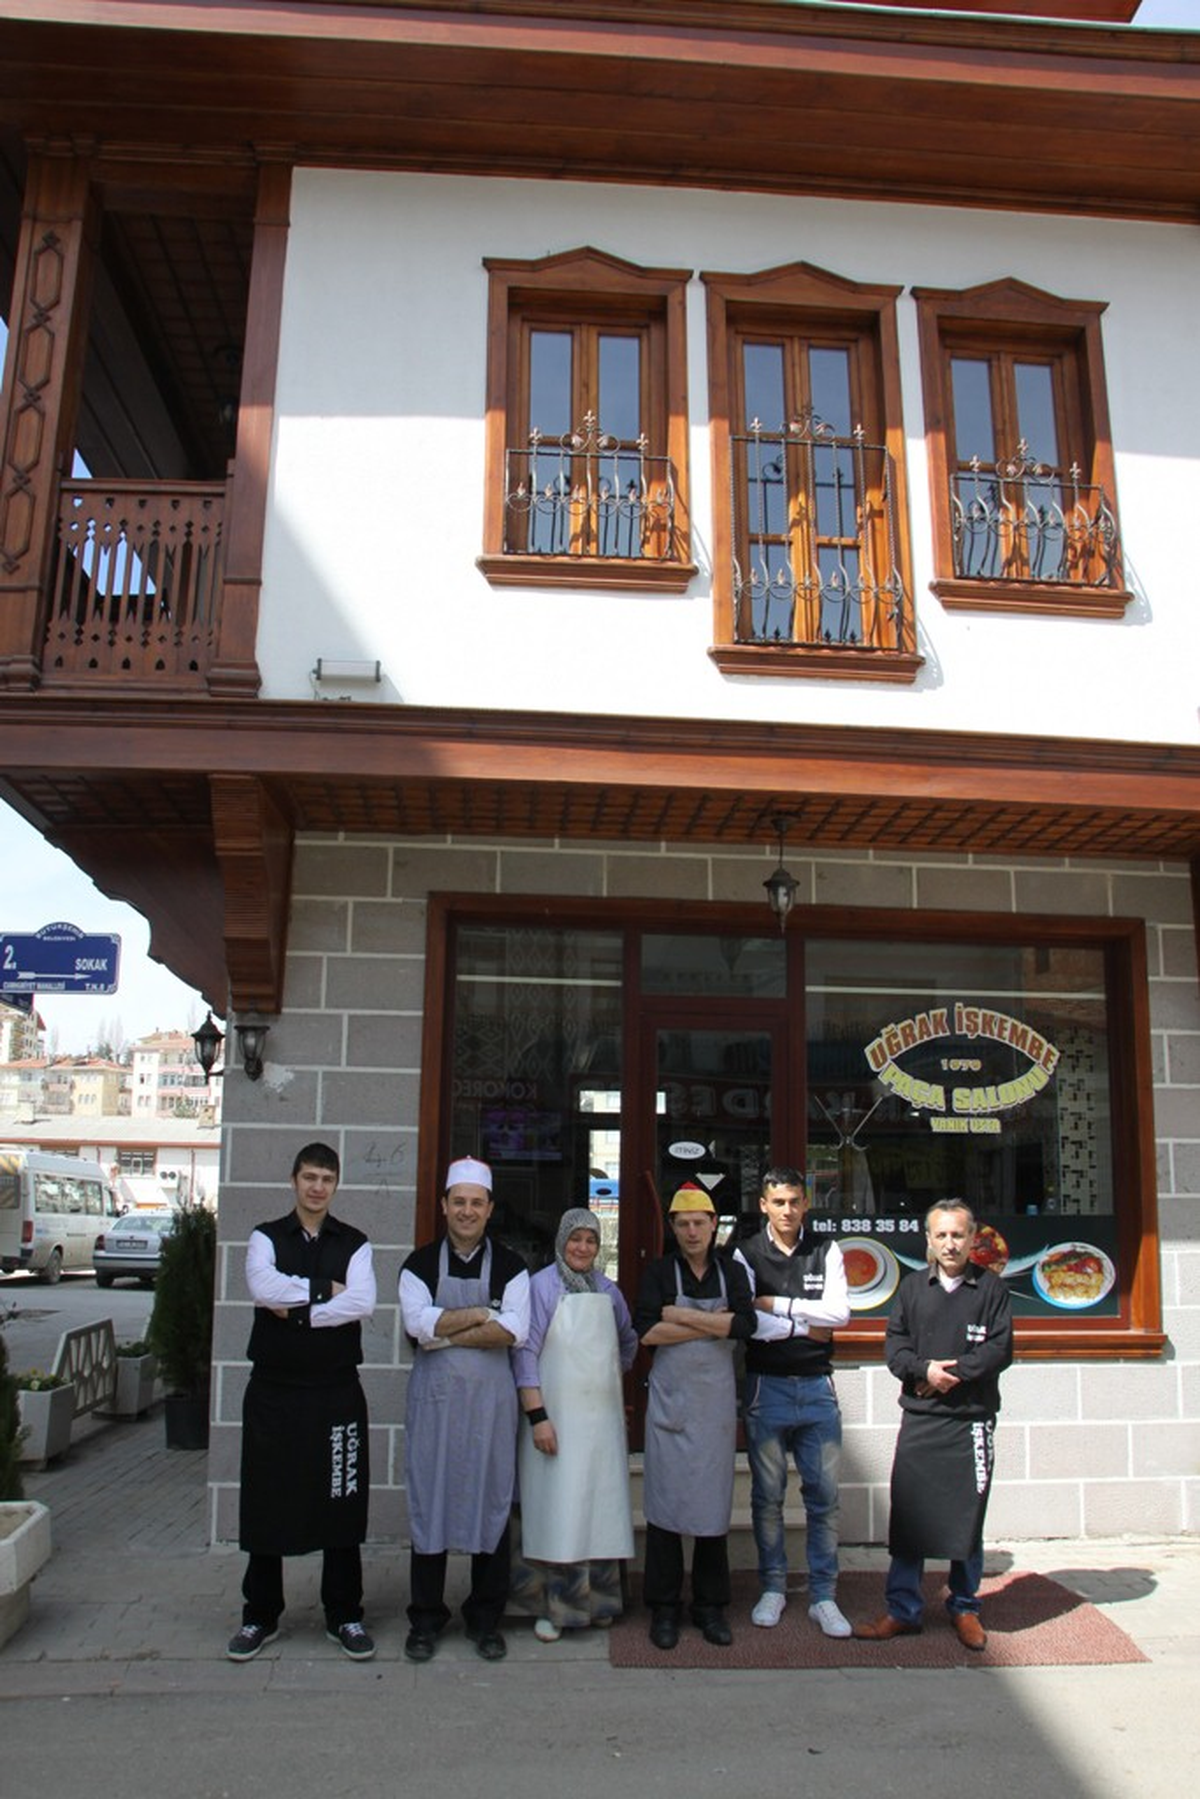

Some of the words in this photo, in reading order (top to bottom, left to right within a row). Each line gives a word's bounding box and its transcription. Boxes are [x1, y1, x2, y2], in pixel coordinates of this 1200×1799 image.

[75, 958, 109, 971] SOKAK
[864, 1008, 950, 1072] UĞRAK
[954, 1002, 1060, 1075] İŞKEMBE
[878, 1060, 946, 1111] PAÇA
[952, 1063, 1050, 1113] SALONU
[812, 1219, 837, 1232] tel:
[841, 1219, 871, 1232] 838
[875, 1219, 895, 1232] 35
[899, 1219, 919, 1232] 84
[330, 1425, 345, 1497] İŞKEMBE
[346, 1422, 360, 1496] UĞRAK
